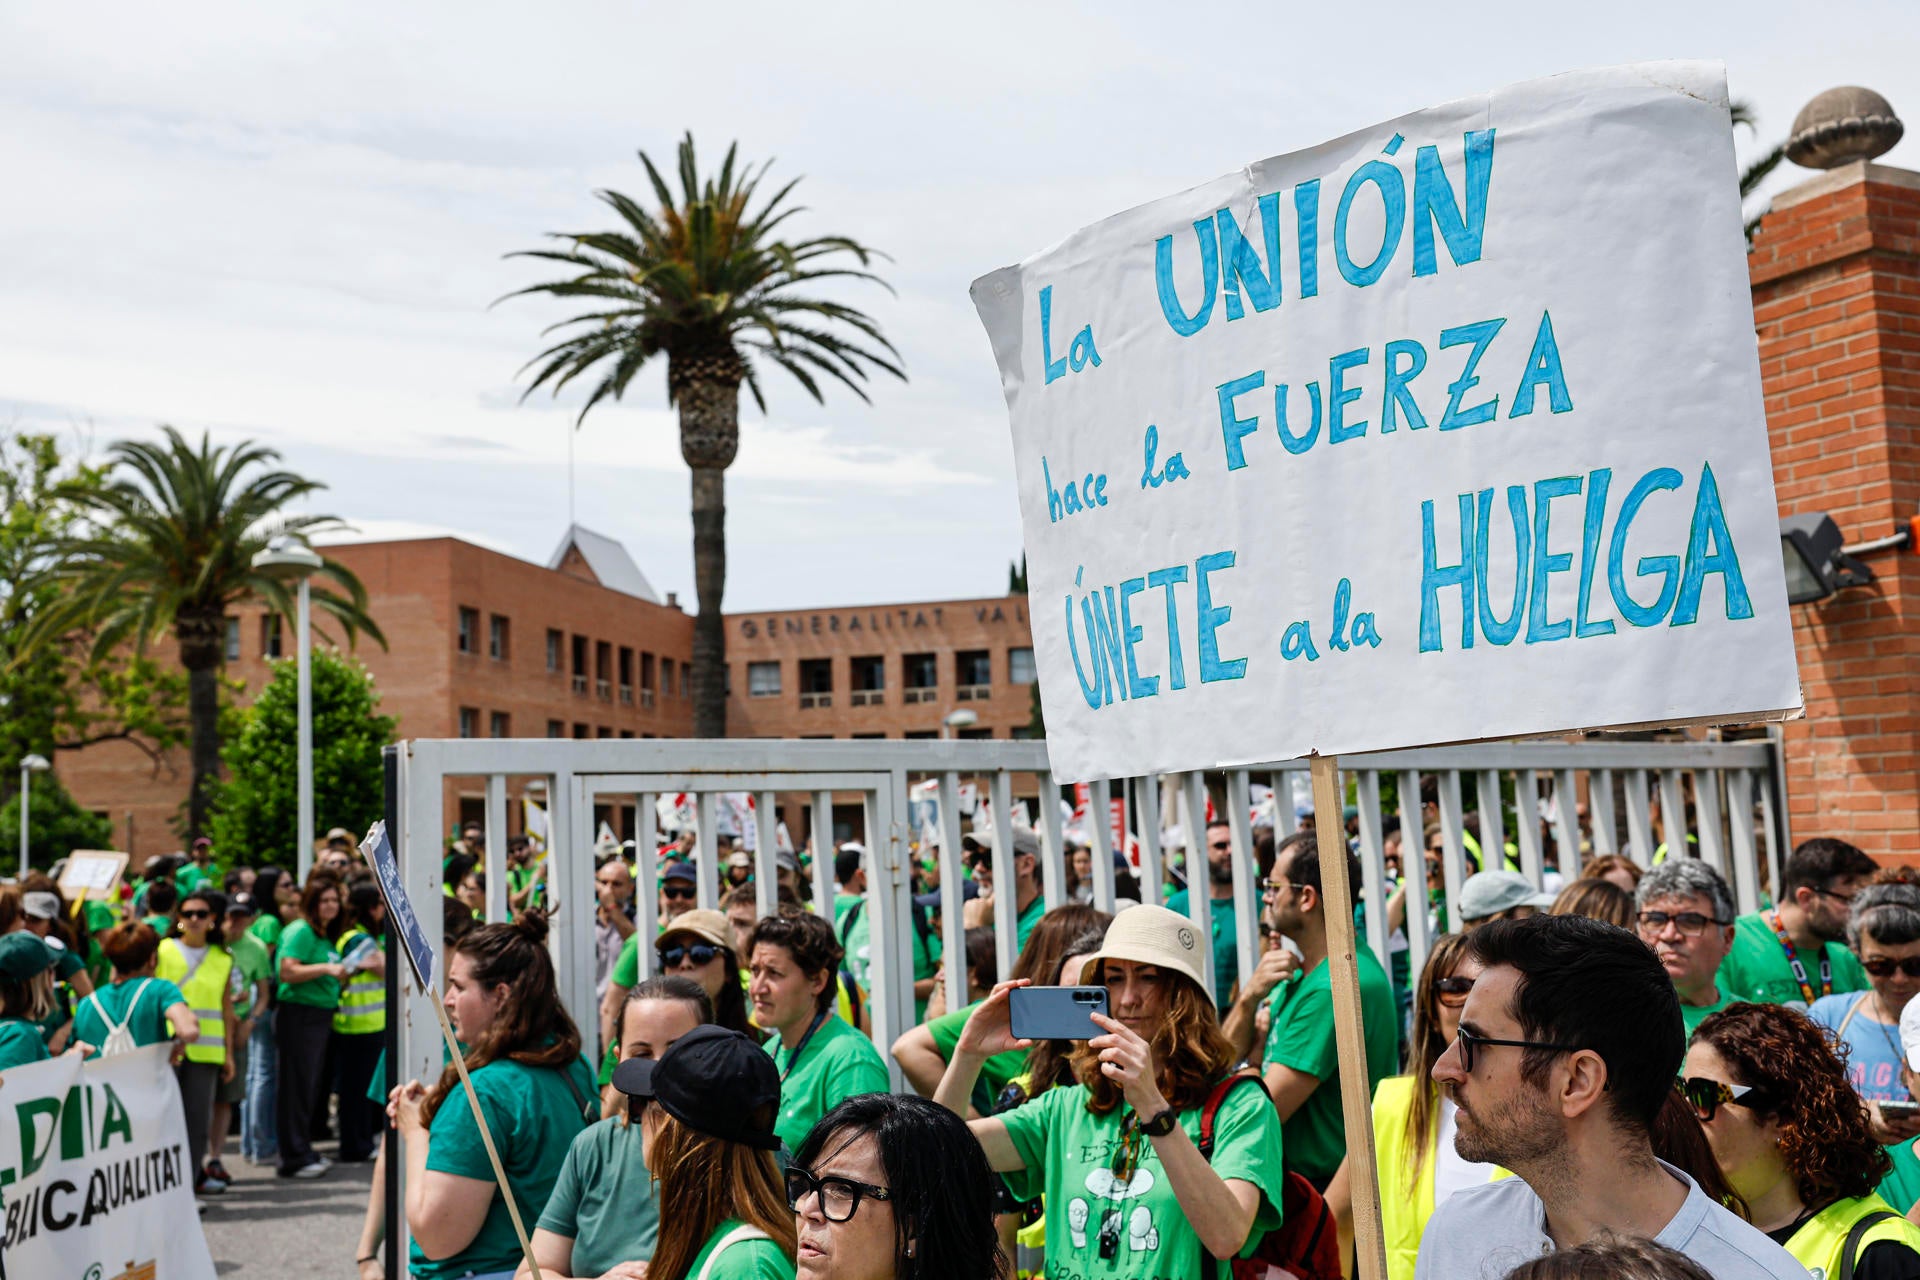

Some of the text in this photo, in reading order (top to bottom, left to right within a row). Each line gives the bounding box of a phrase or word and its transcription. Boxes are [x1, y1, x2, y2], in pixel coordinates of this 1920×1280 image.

[1040, 131, 1496, 384] La UNIÓN
[1043, 310, 1573, 522] hace la FUERZA
[741, 608, 943, 639] GENERALITAT
[1066, 461, 1754, 710] ÚNETE a la HUELGA
[91, 1144, 183, 1216] QUALITAT
